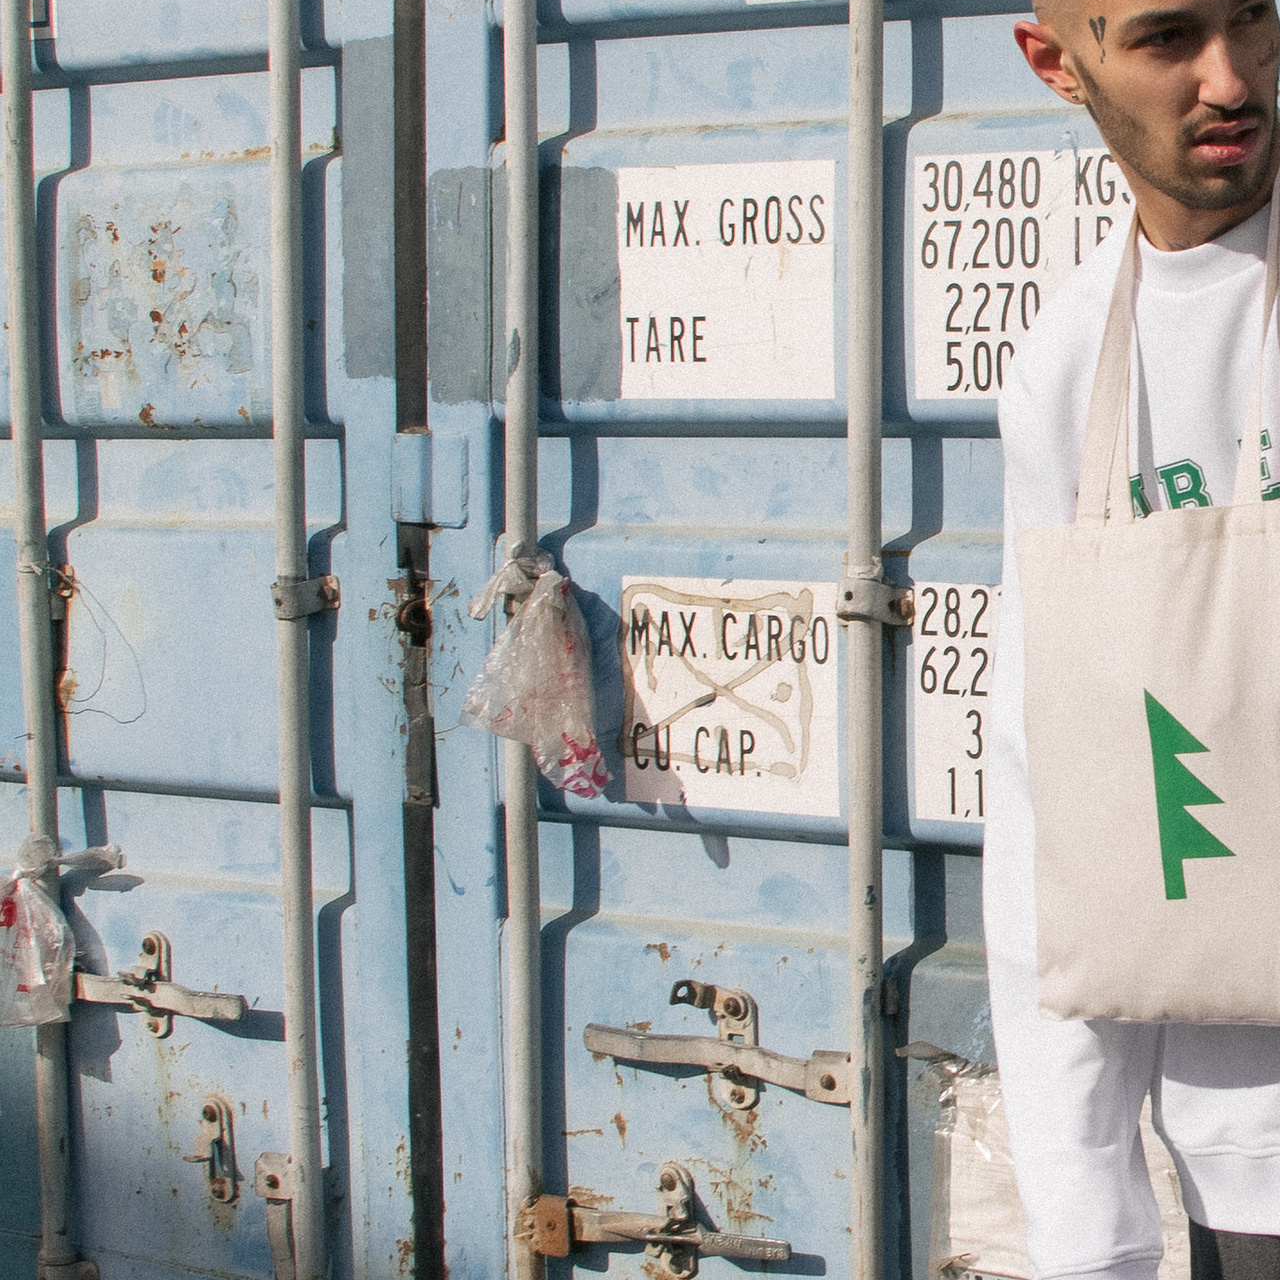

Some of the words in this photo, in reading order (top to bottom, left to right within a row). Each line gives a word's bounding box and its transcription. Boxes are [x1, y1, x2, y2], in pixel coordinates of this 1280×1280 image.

[922, 157, 1041, 212] 30,480
[1074, 154, 1131, 206] KG
[625, 201, 701, 248] MAX.
[719, 195, 826, 246] GROSS
[921, 217, 1041, 270] 67,200
[945, 281, 1040, 335] 2,270
[626, 317, 707, 363] TARE
[630, 608, 707, 659] MAX.
[721, 613, 829, 664] CARGO
[920, 646, 988, 697] 62,2
[632, 722, 680, 771] CU.
[694, 726, 762, 777] CAP.
[947, 766, 984, 817] 1,1
